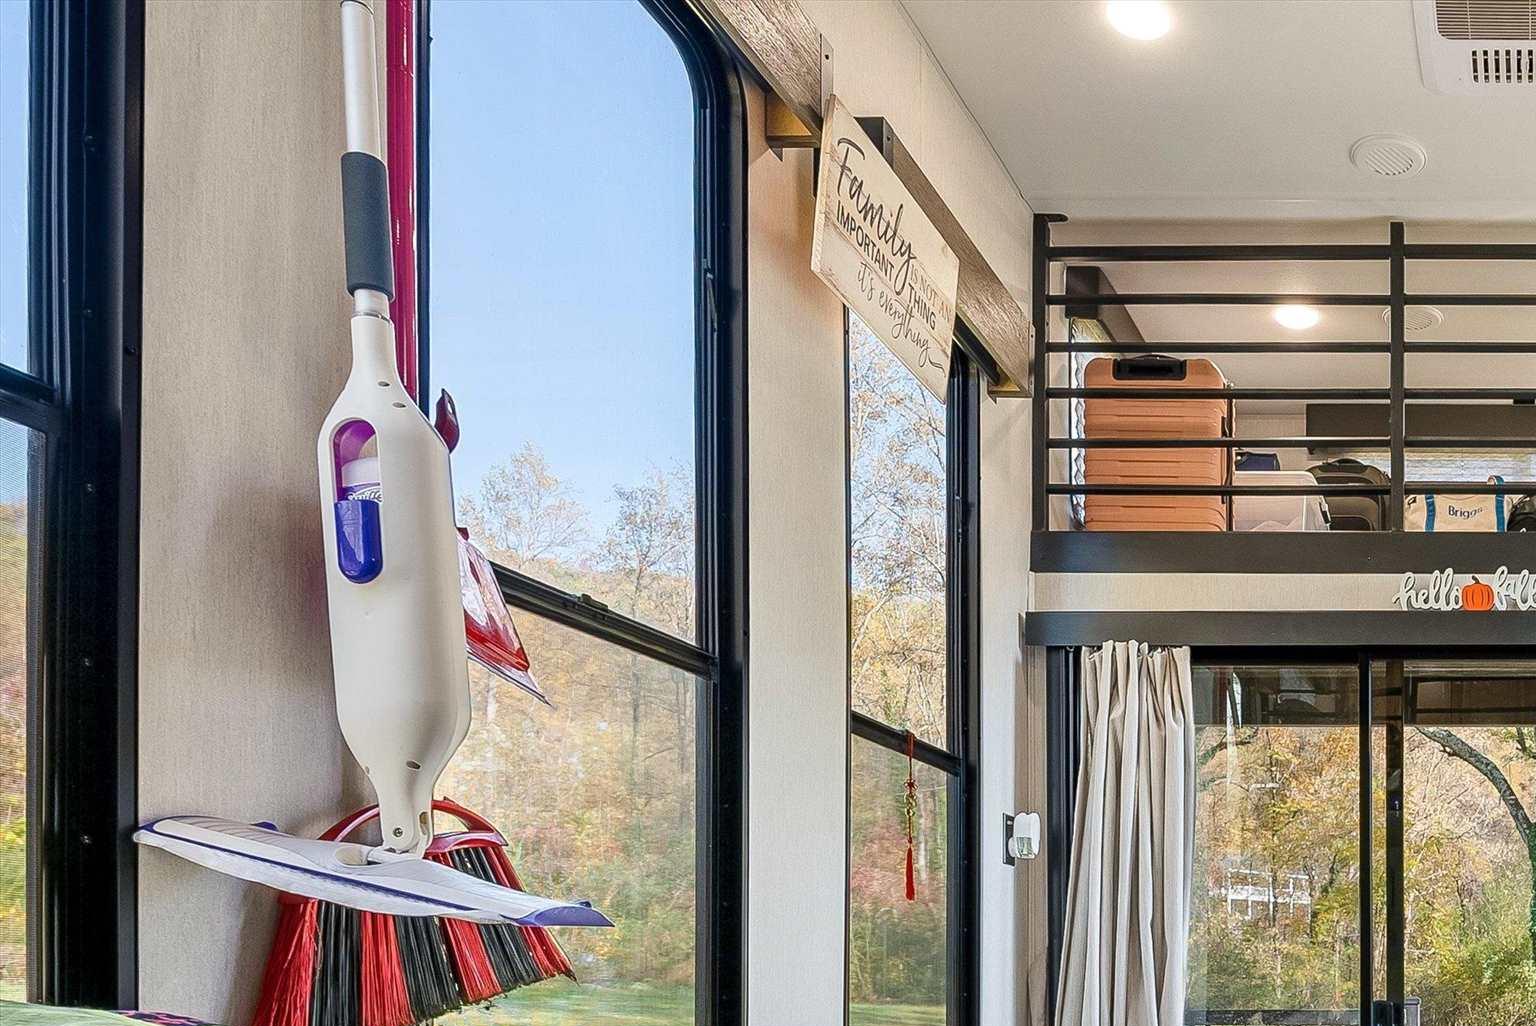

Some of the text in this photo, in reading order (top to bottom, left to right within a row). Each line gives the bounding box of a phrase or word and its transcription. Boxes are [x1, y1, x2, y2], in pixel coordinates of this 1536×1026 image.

[837, 138, 917, 296] Family
[837, 200, 937, 331] IMPORTANT THING
[857, 261, 946, 377] it's everything
[910, 263, 950, 322] IS NOT AN
[1392, 567, 1463, 611] hello
